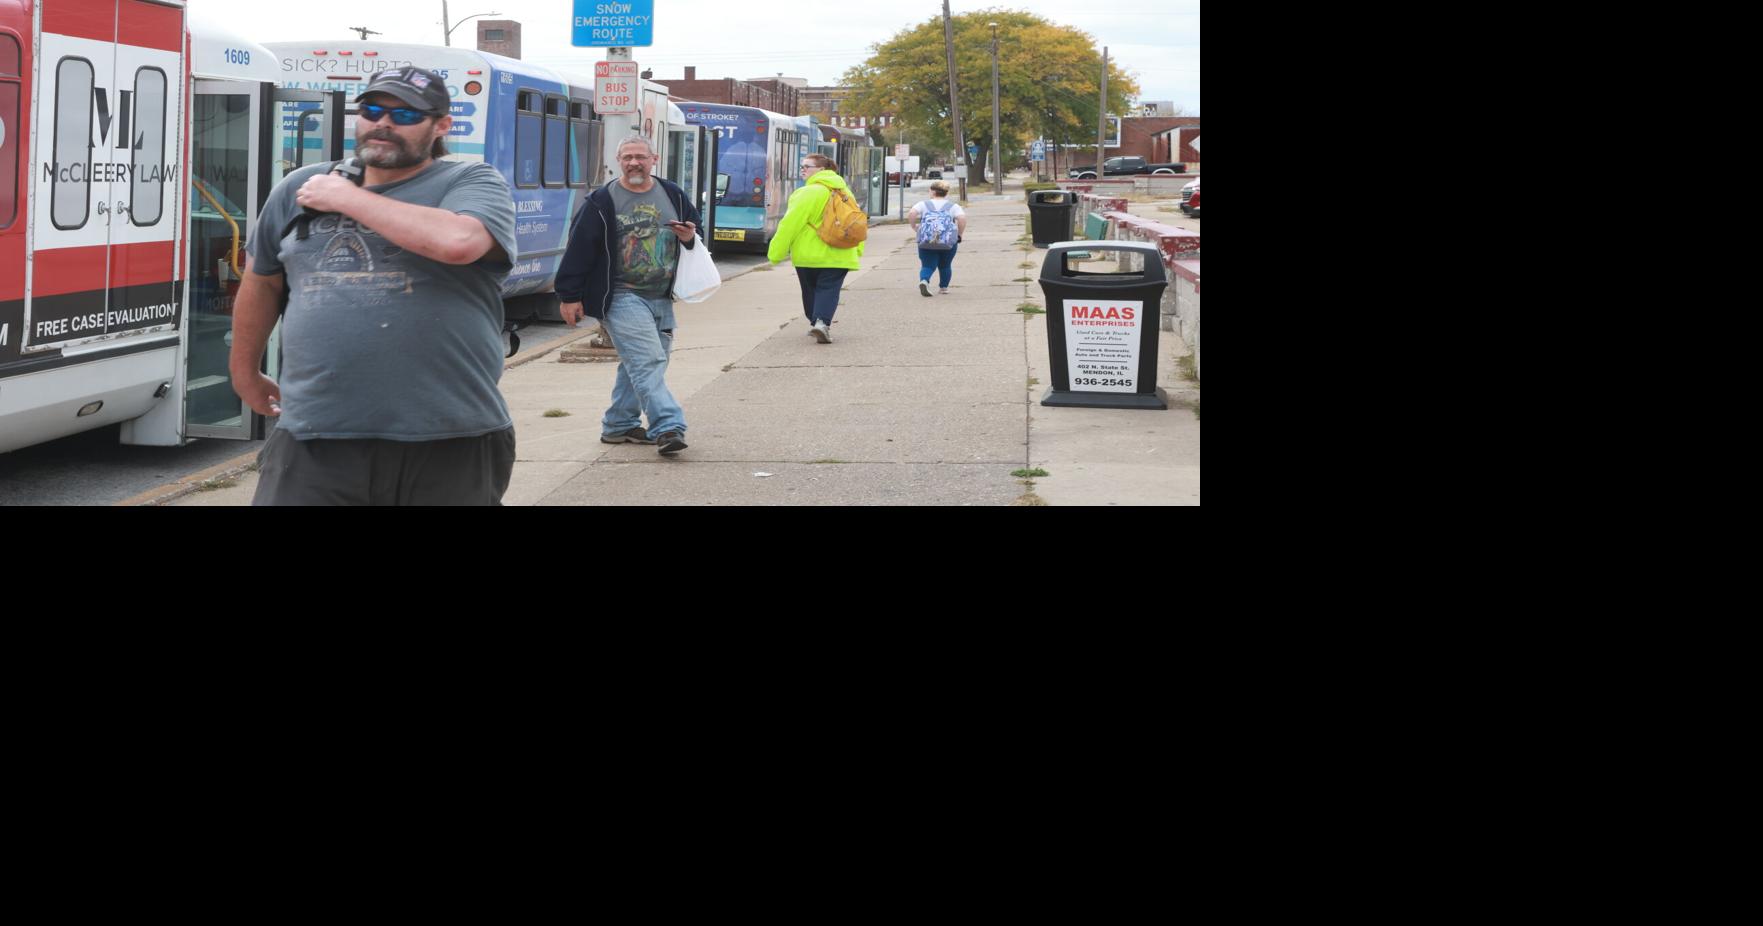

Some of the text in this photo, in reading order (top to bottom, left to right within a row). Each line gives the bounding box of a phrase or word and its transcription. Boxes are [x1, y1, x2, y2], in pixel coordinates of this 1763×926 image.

[596, 4, 632, 14] SNOW
[574, 15, 650, 26] EMERGENCY
[592, 28, 633, 39] ROUTE
[224, 48, 250, 65] 1609
[282, 58, 338, 72] SICK?
[596, 64, 609, 75] NO
[605, 83, 628, 92] BUS
[601, 96, 630, 105] STOP
[140, 164, 176, 183] LAW
[1071, 306, 1135, 319] MAAS
[36, 302, 179, 338] FREE CASE EVALUATION
[1074, 377, 1133, 387] 936-2545
